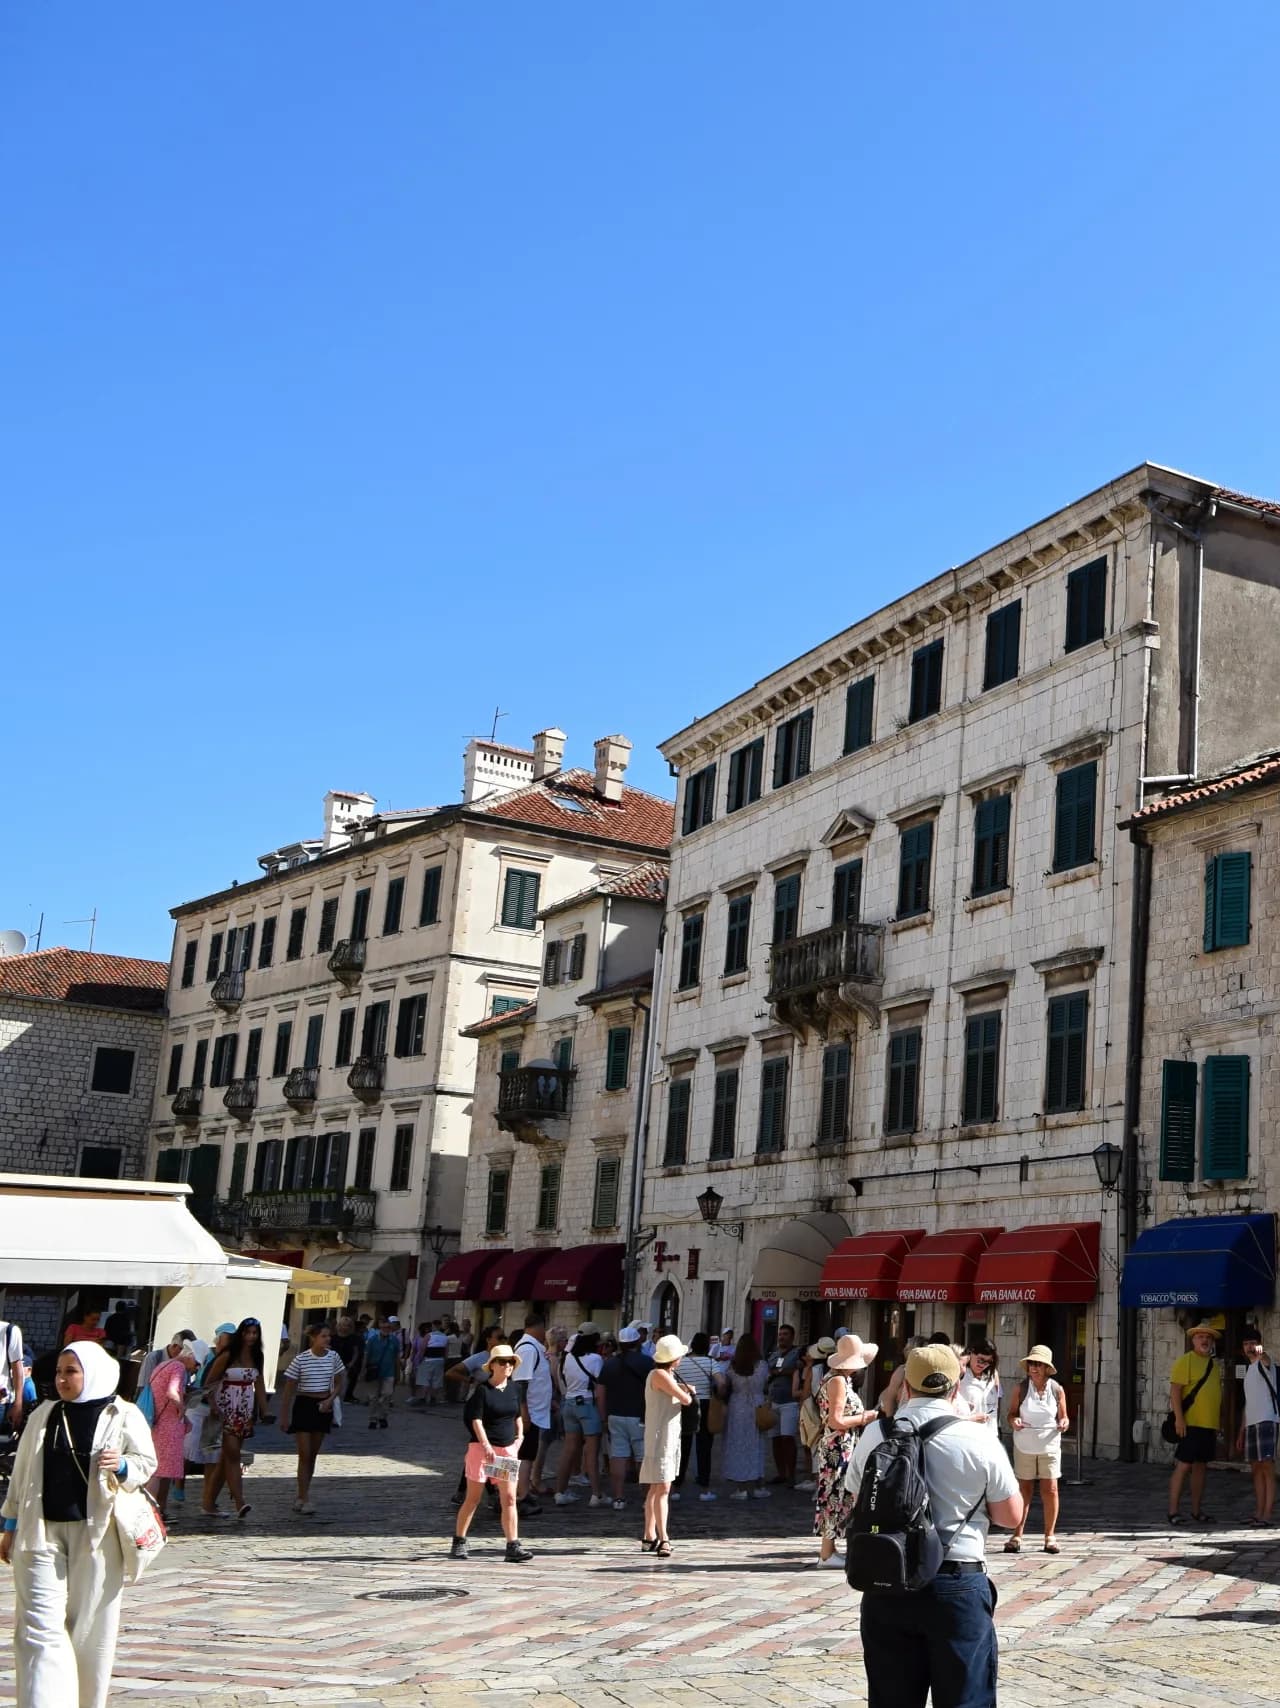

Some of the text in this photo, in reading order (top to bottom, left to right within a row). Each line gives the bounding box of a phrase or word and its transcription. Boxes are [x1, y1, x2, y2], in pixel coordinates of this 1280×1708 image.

[799, 1290, 821, 1298] FOTO
[824, 1287, 868, 1298] PRVA BANKA CG
[899, 1289, 948, 1301] PRVA BANKA CG
[980, 1288, 1037, 1301] PRVA BANKA CG
[1140, 1293, 1169, 1303] TOBACCO
[1177, 1294, 1199, 1303] PRESS
